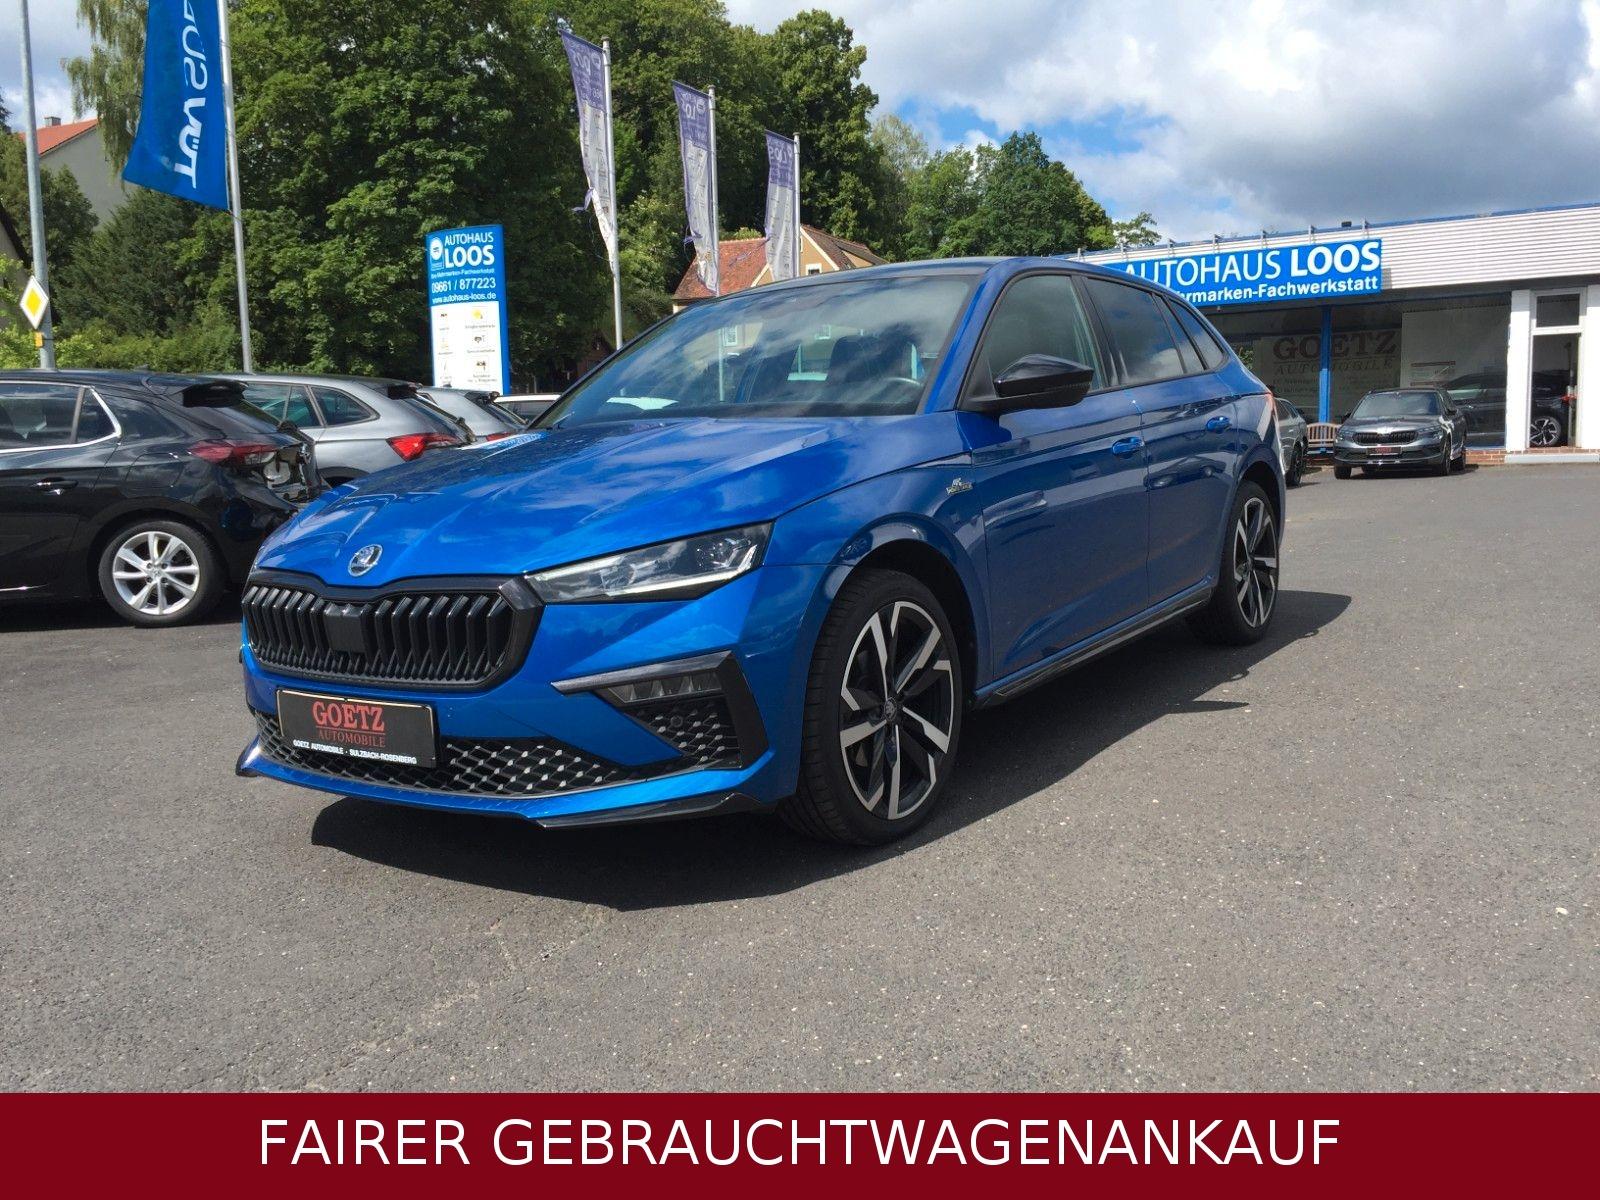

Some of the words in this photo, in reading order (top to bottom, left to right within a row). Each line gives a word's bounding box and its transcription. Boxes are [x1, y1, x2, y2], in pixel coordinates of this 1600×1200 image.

[445, 232, 494, 246] AUTOHAUS
[445, 244, 495, 268] LOOS
[1290, 241, 1380, 277] LOOS
[459, 277, 497, 291] 877223
[1273, 332, 1397, 359] GOETZ
[312, 701, 385, 732] GOETZ
[293, 739, 310, 749] GOETZ
[311, 742, 344, 755] AUTOMOBILE
[349, 748, 417, 765] SULZBACH-ROSENBERG
[318, 731, 386, 748] AUTOMOBILE
